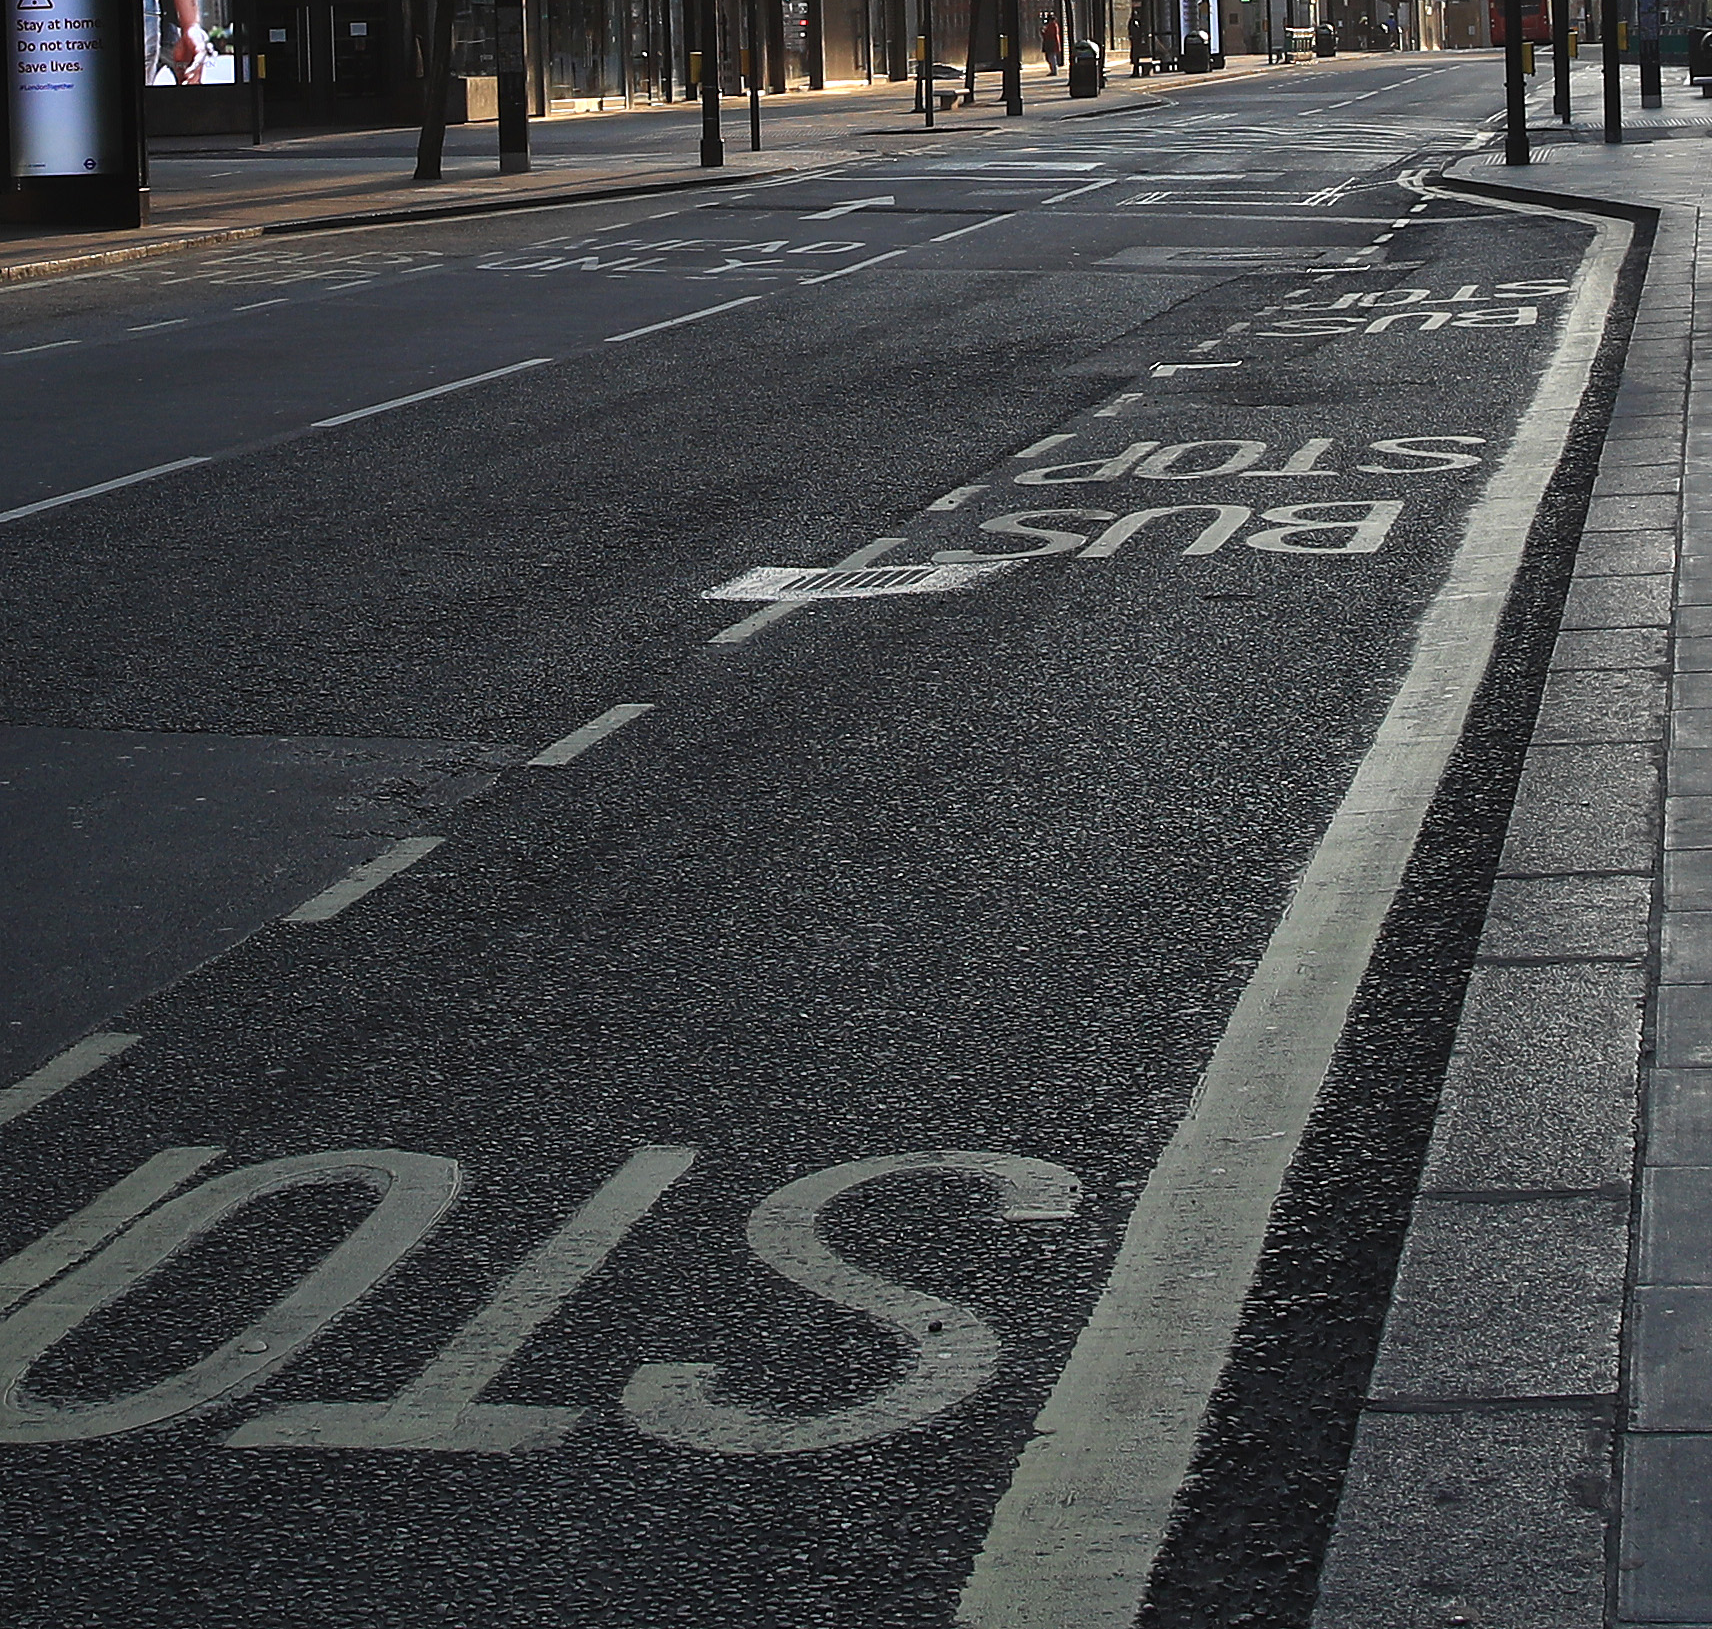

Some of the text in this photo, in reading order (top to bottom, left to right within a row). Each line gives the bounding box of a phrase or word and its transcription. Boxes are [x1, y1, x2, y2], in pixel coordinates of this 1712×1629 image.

[16, 19, 45, 33] Stay
[47, 18, 61, 30] at
[17, 40, 36, 52] Do
[40, 39, 62, 51] not
[17, 60, 84, 73] Save lives.
[19, 82, 75, 92] #LondonTogether
[475, 255, 786, 274] ONLY
[1282, 279, 1571, 311] STOP
[1255, 305, 1538, 337] BUS
[1014, 435, 1487, 485] STOP
[931, 499, 1406, 563] BUS
